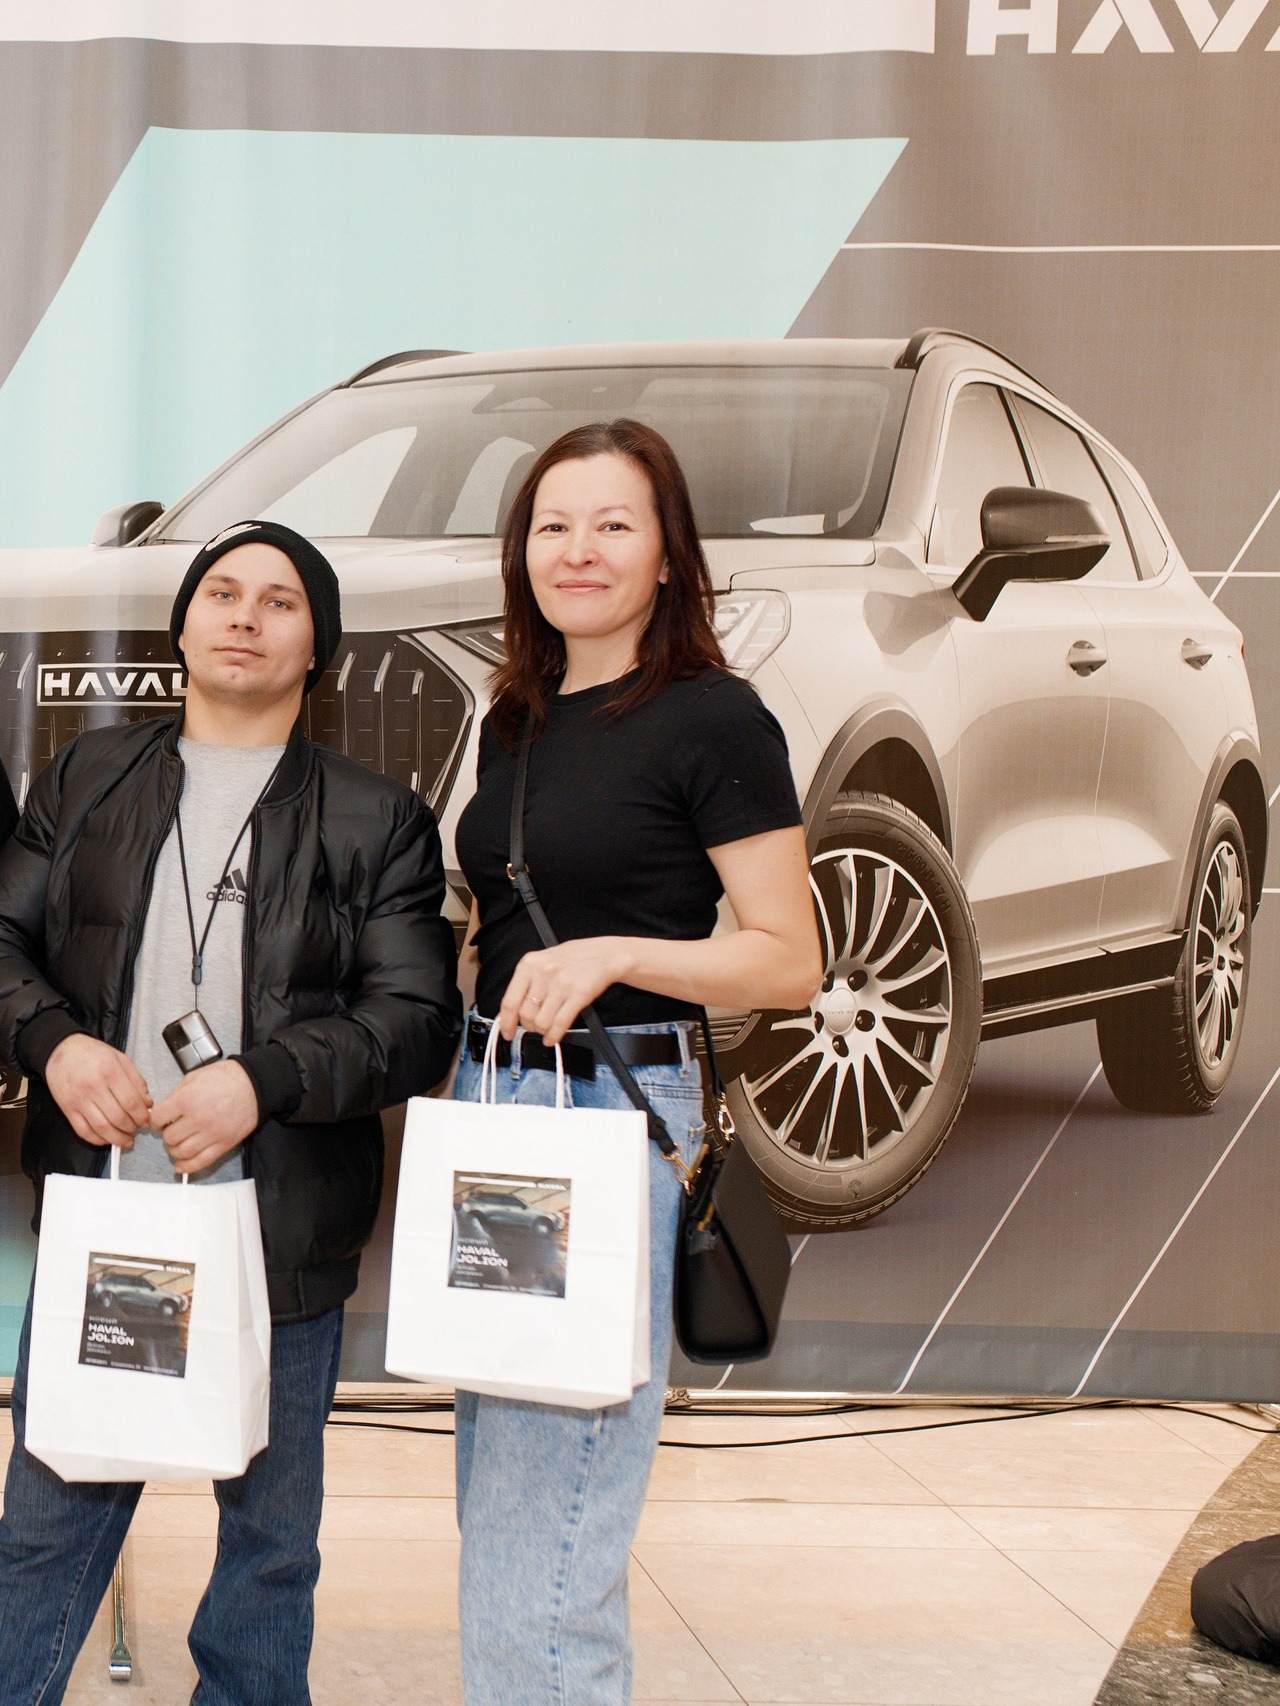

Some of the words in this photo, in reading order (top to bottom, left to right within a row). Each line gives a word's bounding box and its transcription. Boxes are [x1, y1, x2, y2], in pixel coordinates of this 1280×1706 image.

[966, 0, 1280, 55] HAV
[44, 672, 188, 697] HAVAL
[206, 889, 245, 905] adida
[456, 1244, 500, 1258] HAVAL
[456, 1254, 508, 1268] JOLION
[88, 1322, 128, 1336] HAVAL
[87, 1332, 135, 1346] JOLION
